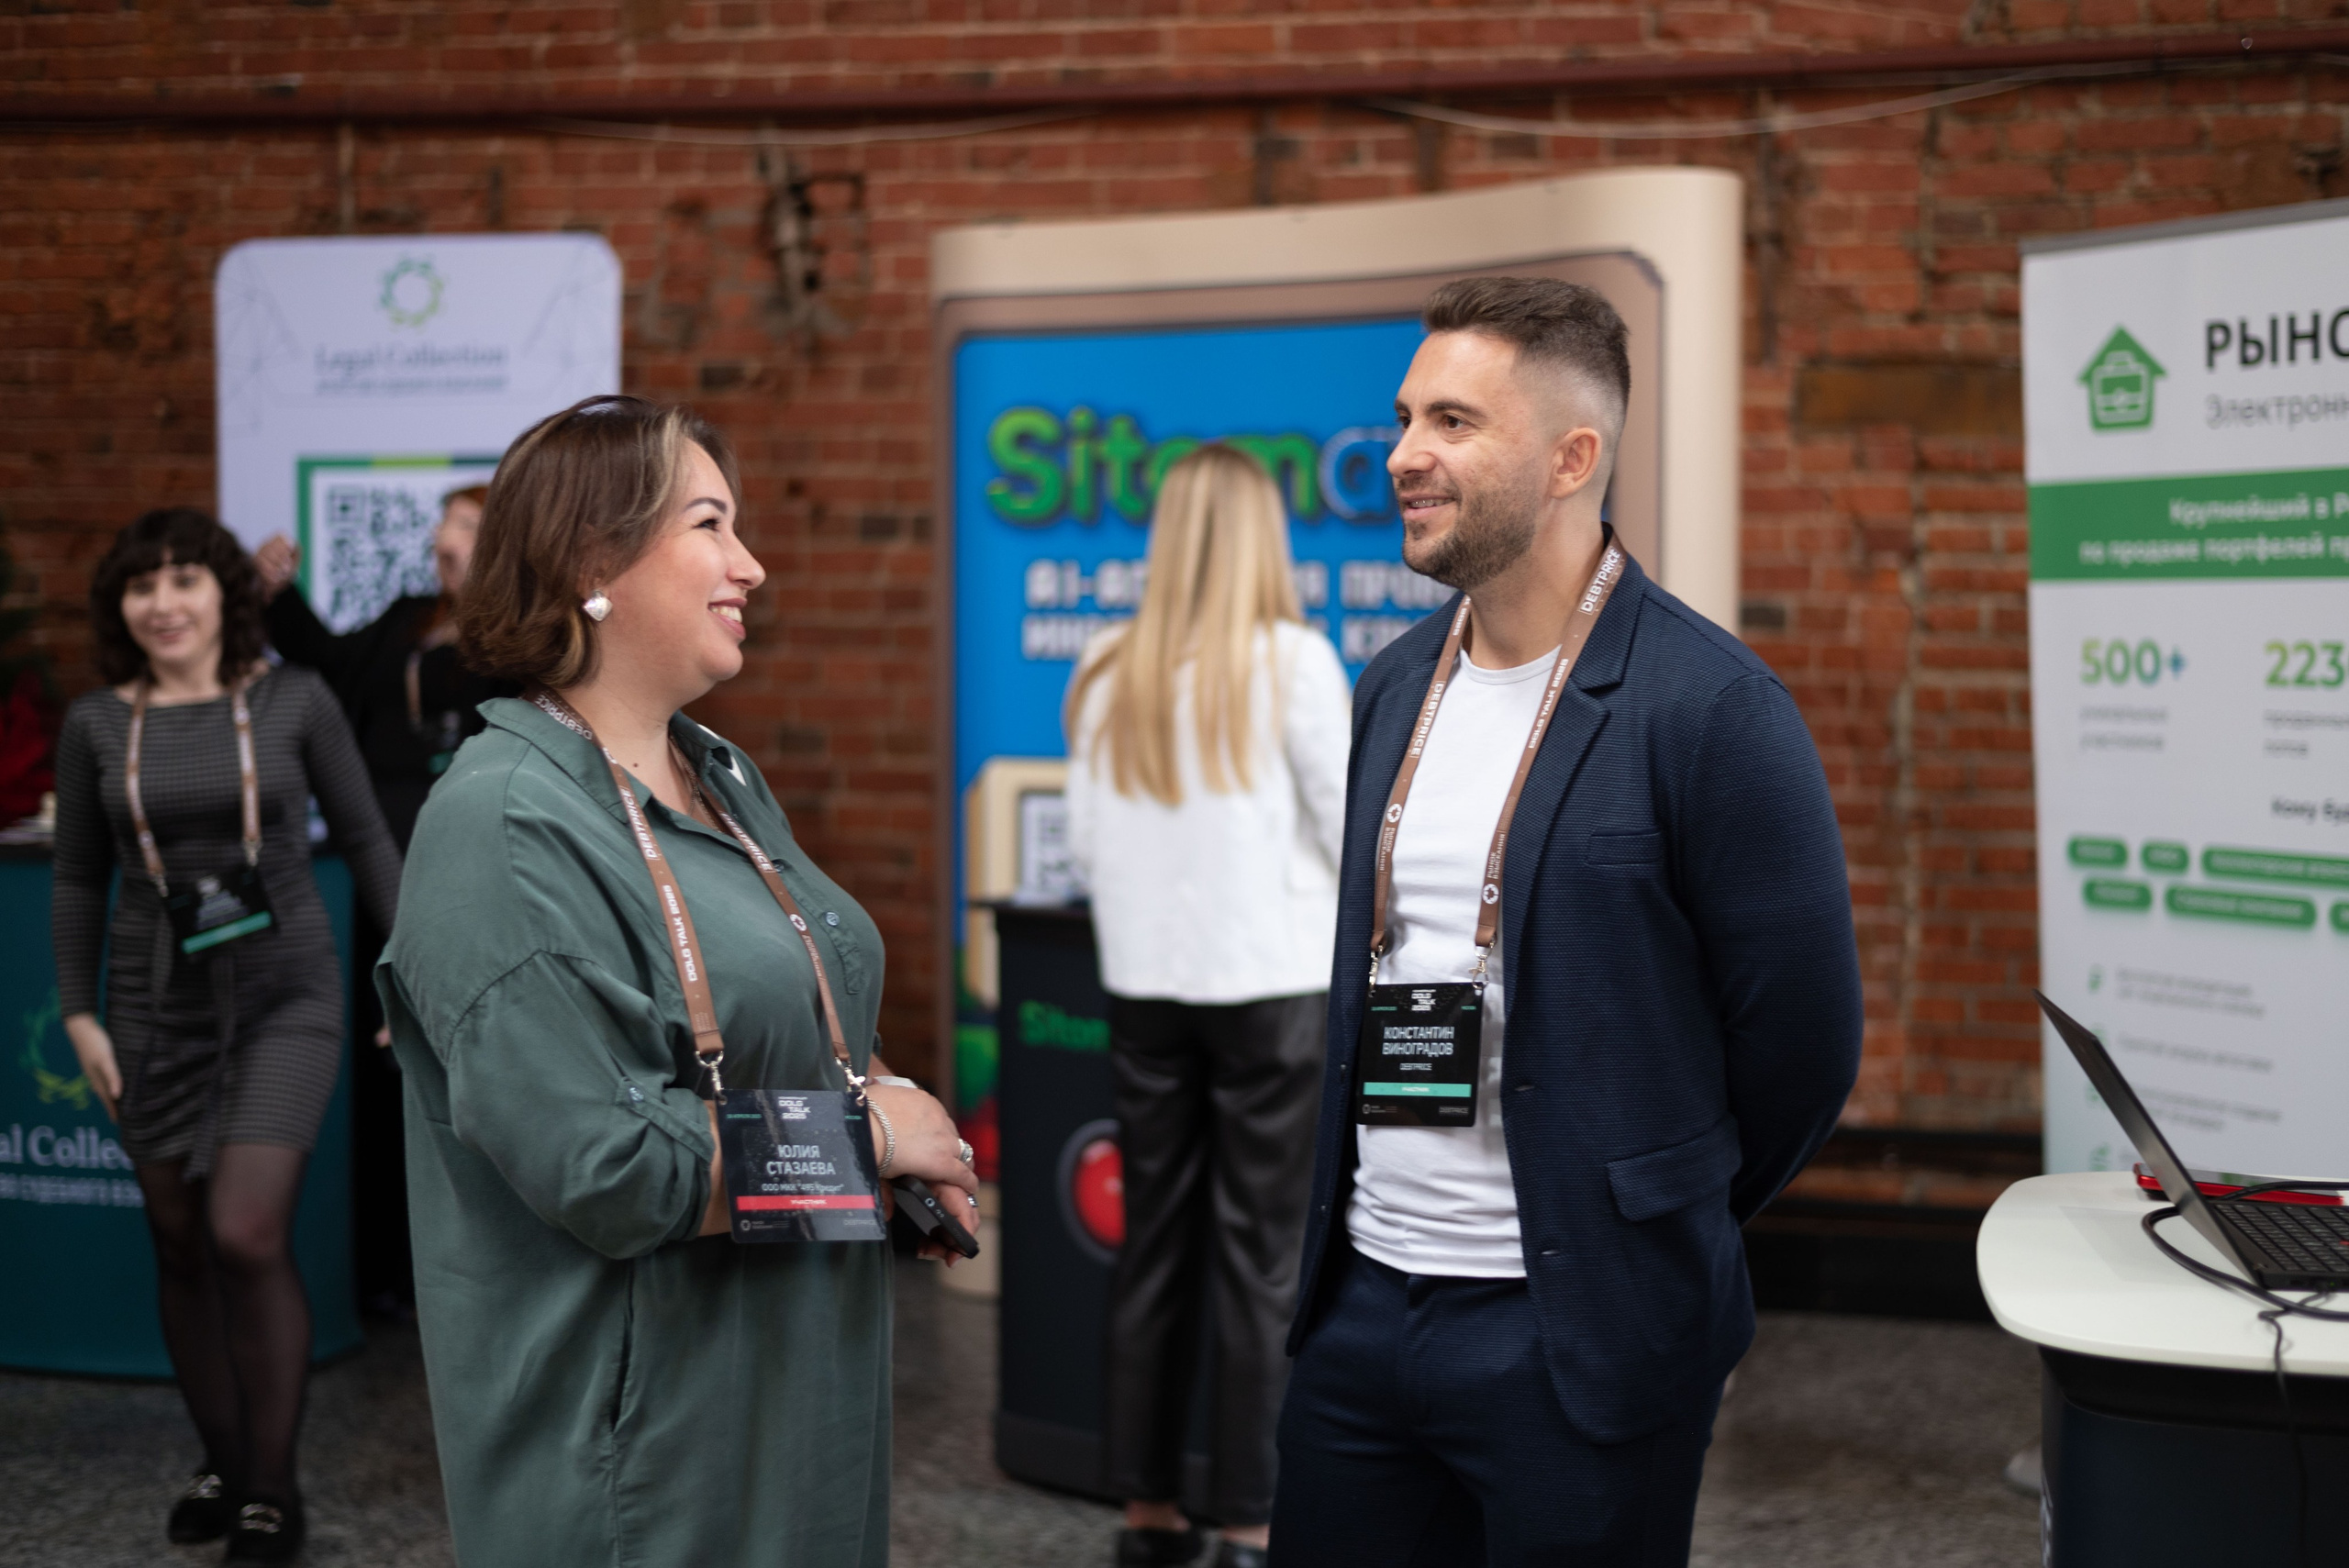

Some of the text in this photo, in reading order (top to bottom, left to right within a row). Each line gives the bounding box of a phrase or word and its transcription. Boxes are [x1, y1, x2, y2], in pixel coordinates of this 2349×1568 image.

[1580, 549, 1620, 613] DEBTPRICE
[2081, 639, 2187, 685] 500+
[2266, 639, 2349, 687] 223
[535, 695, 594, 740] DEBTPRICE
[1540, 689, 1556, 717] TALK
[1410, 683, 1445, 756] DEBTPRICE
[674, 917, 689, 947] TALK
[681, 948, 698, 982] DOLG
[1384, 1026, 1455, 1040] КОНСТАНТИН
[1382, 1042, 1453, 1057] ВИНОГРАДОВ
[778, 1144, 820, 1158] ЮЛИЯ
[766, 1161, 836, 1175] СТАЗАЕВА
[762, 1183, 779, 1191] ООО
